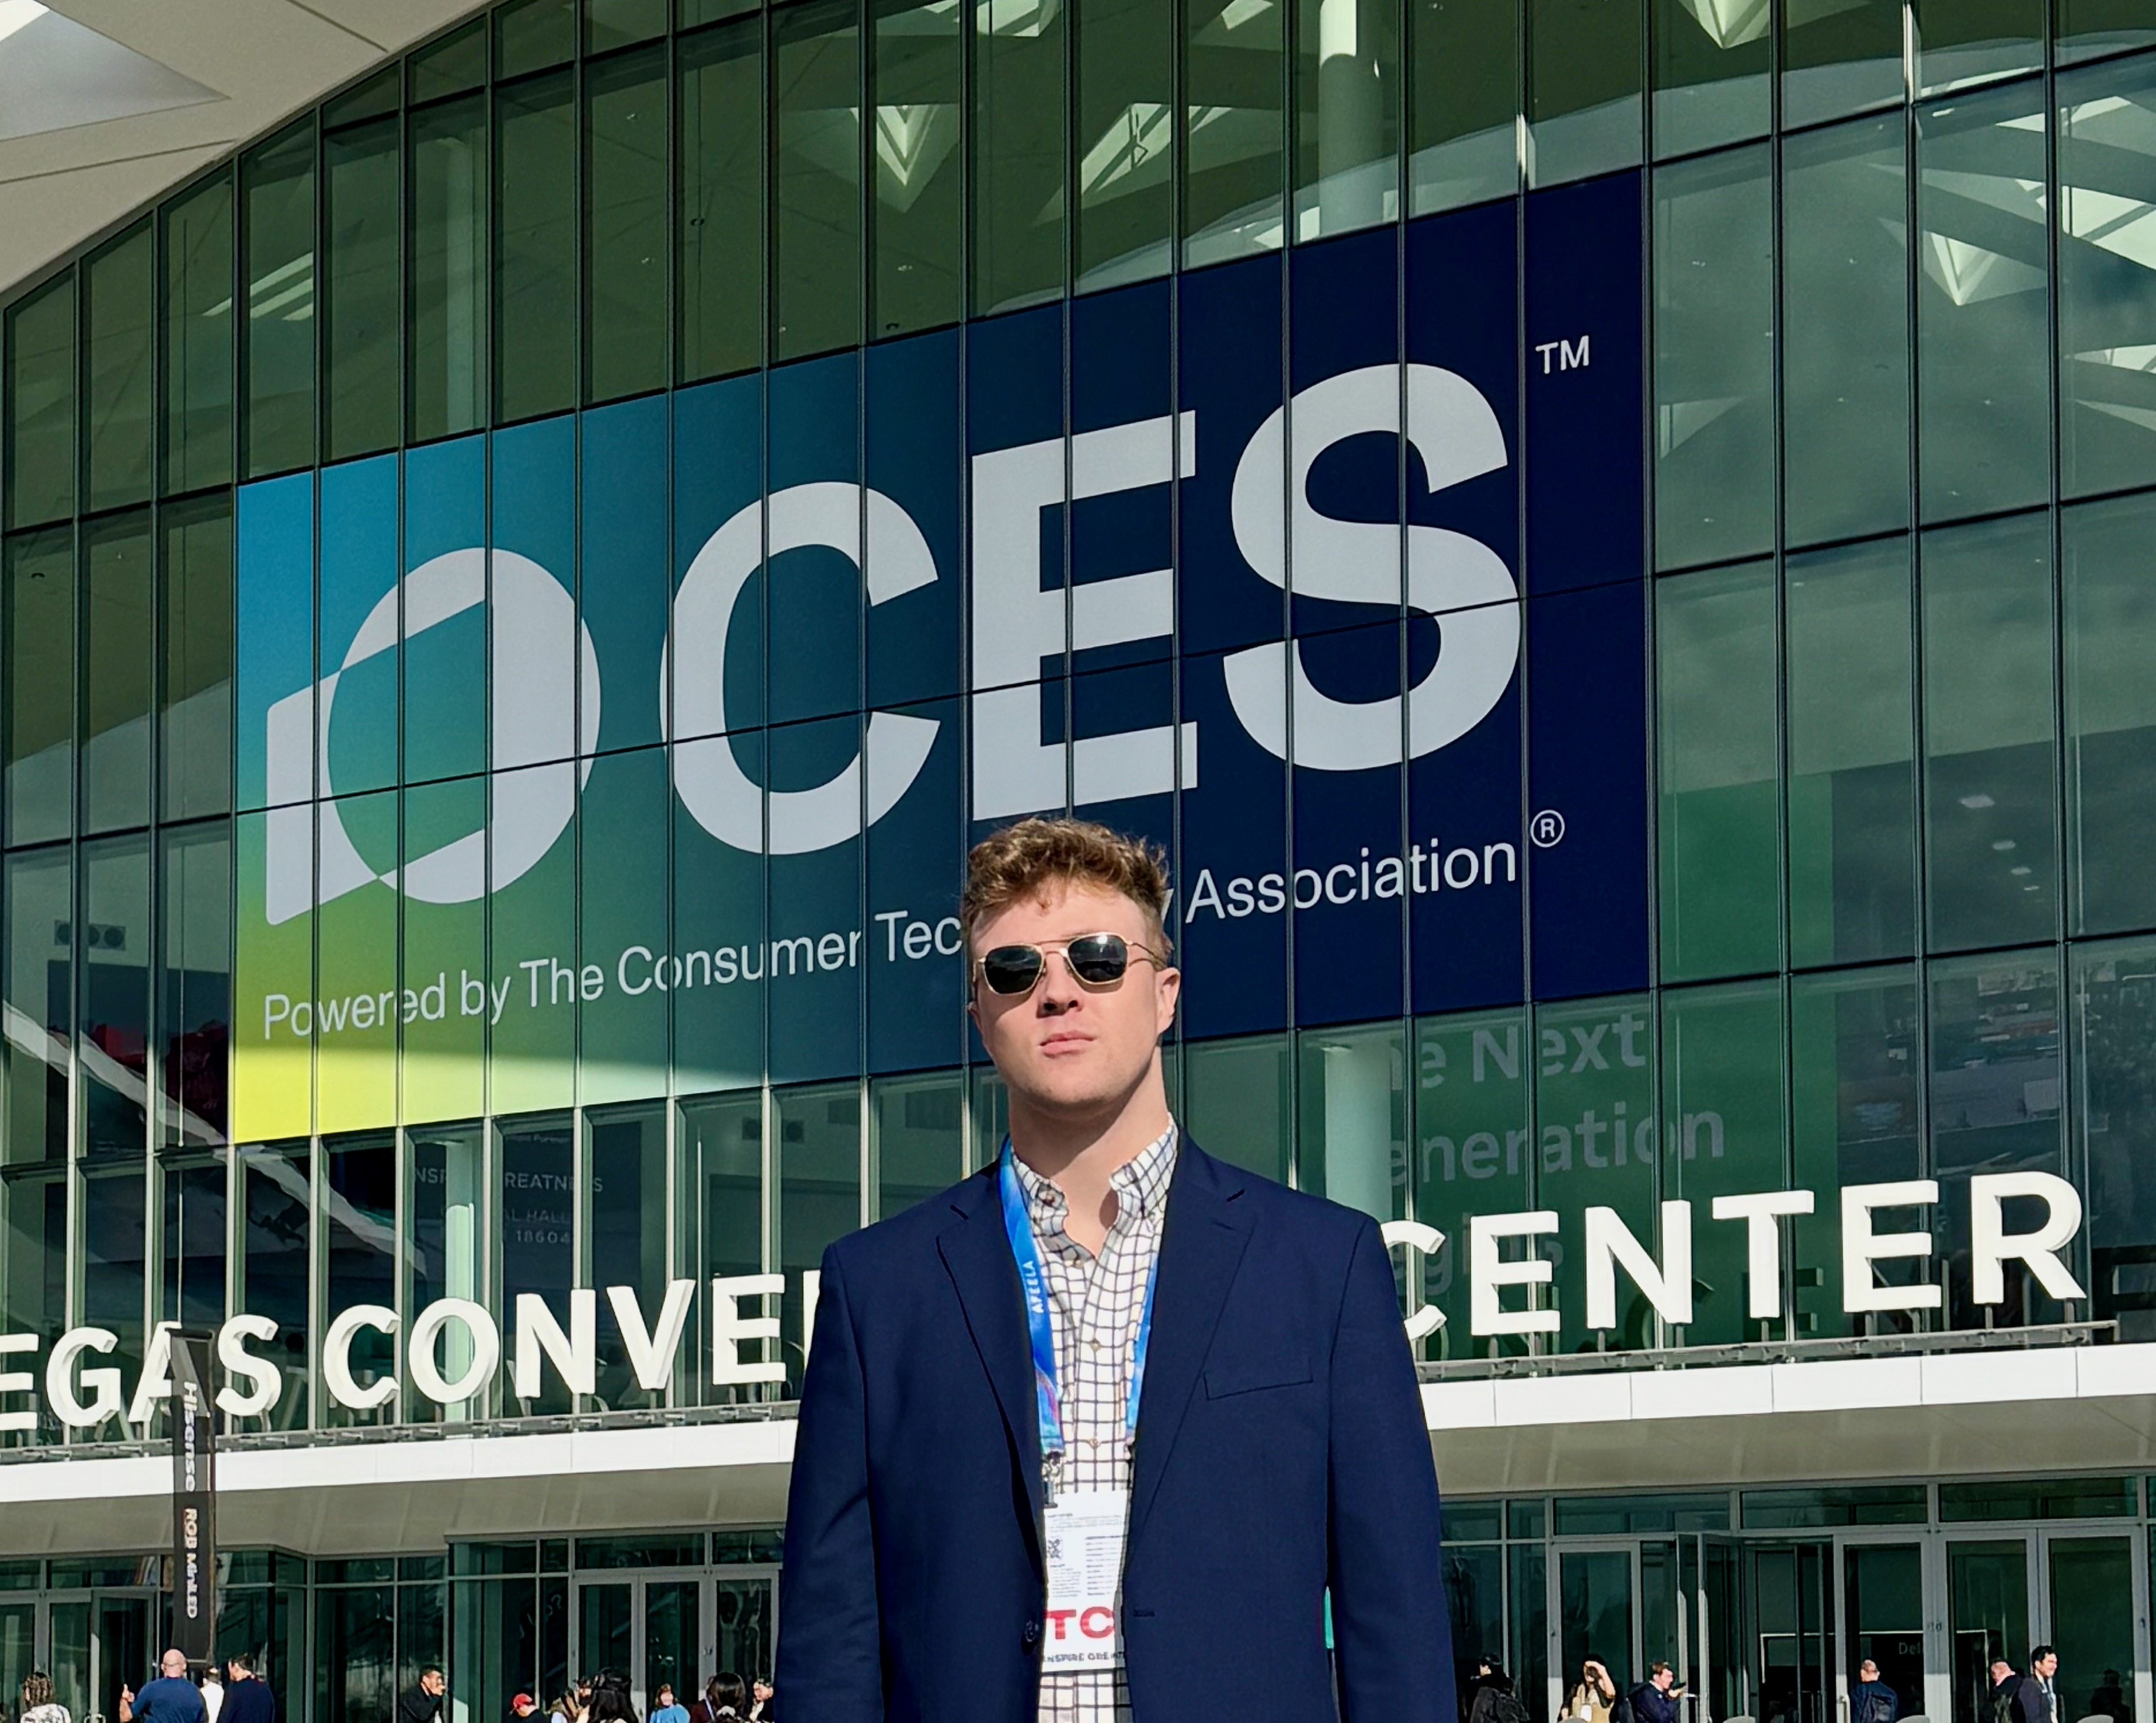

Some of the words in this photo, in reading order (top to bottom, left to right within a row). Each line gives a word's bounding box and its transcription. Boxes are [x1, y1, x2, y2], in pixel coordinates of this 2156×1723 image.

[659, 363, 1522, 855] CES
[264, 972, 446, 1040] Powered
[460, 969, 510, 1025] by
[519, 958, 604, 1007] The
[618, 931, 862, 995] Consumer
[1185, 838, 1517, 924] Association
[1473, 1013, 1647, 1082] Next
